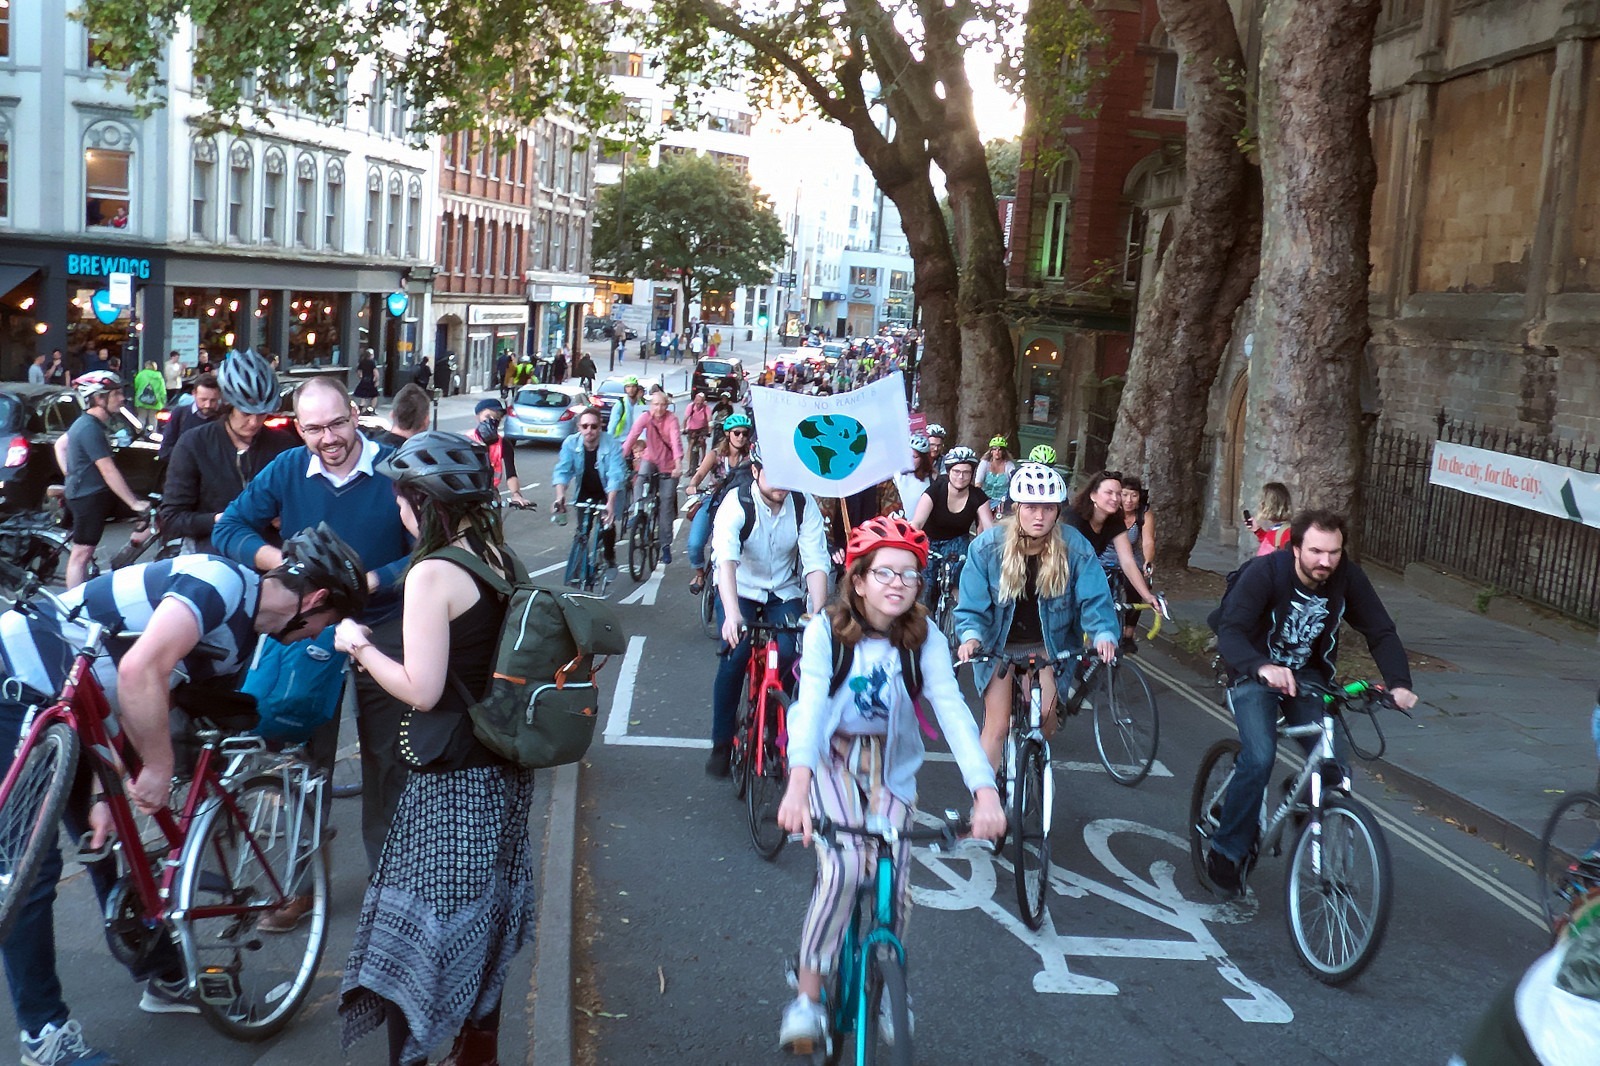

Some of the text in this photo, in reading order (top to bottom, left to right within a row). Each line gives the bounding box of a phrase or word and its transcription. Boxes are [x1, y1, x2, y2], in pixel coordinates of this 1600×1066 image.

[67, 253, 150, 279] BREWDOG
[764, 388, 877, 410] THERE IS NO PLANET B
[1438, 454, 1542, 499] In the city, for the city.
